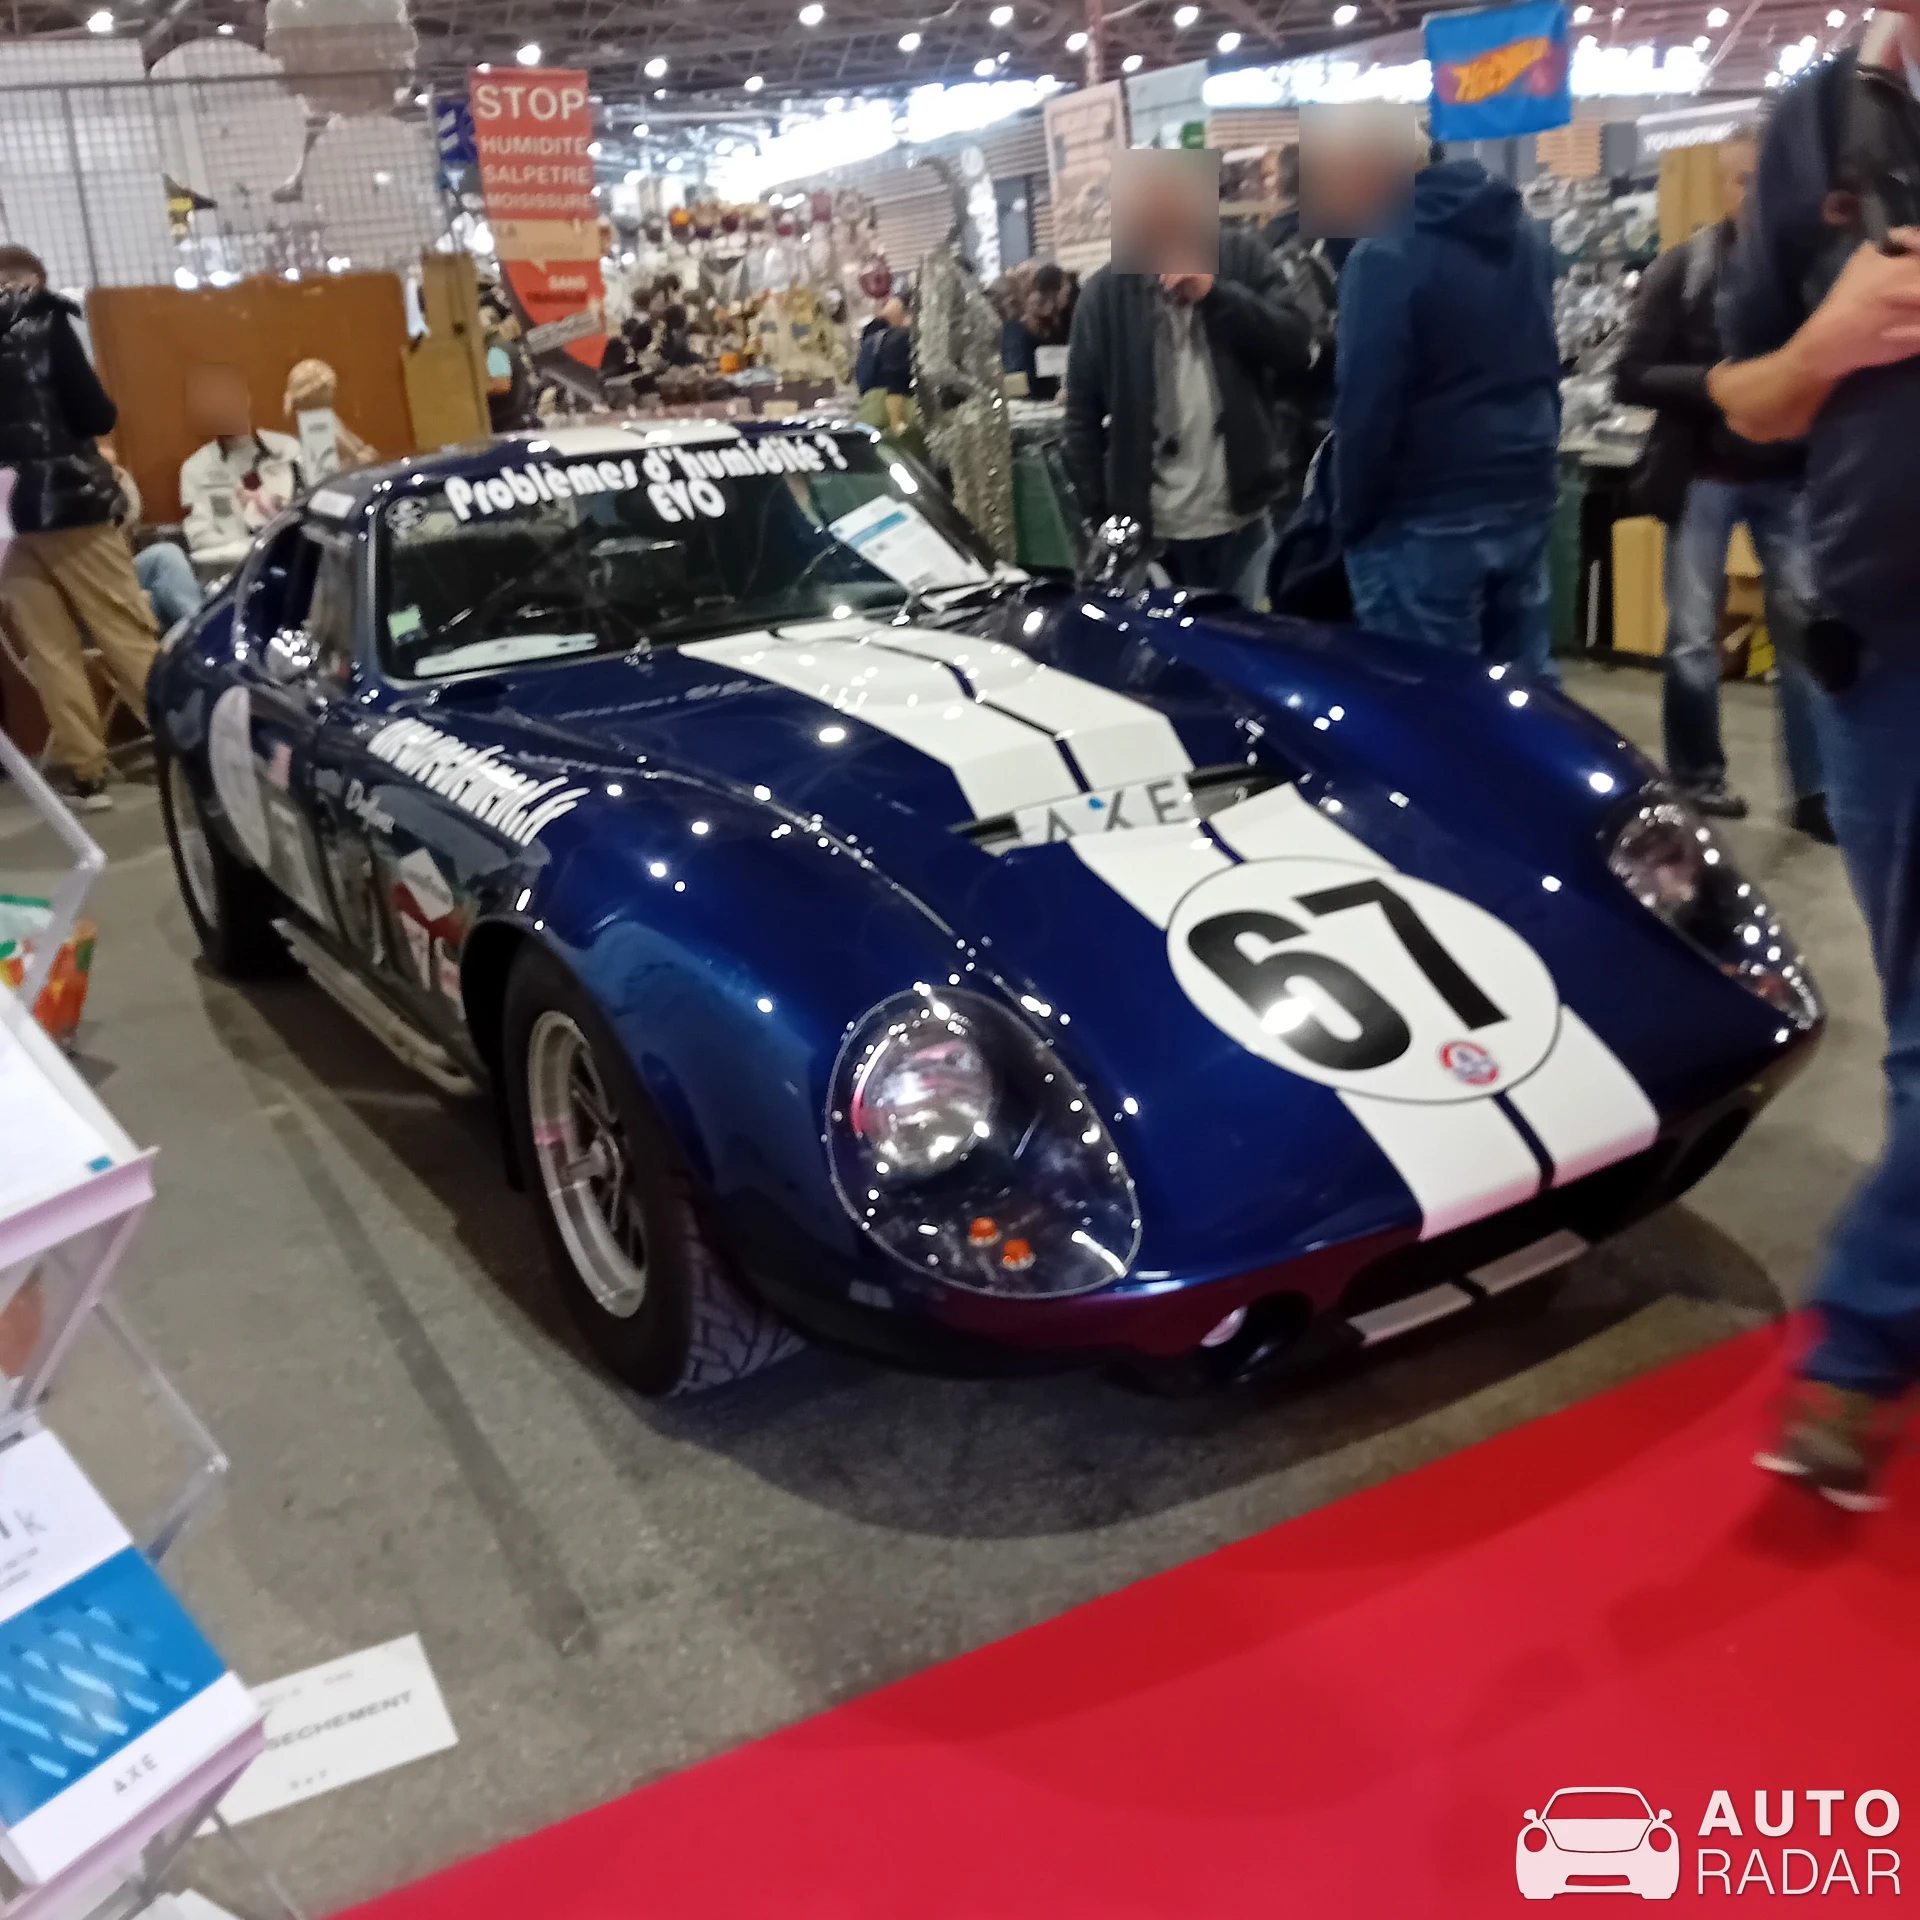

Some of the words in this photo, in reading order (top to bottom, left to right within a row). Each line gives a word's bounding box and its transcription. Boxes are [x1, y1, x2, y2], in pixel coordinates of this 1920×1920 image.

[475, 84, 585, 121] STOP
[483, 163, 592, 186] SALPETRE
[444, 458, 639, 522] Problèmes
[813, 433, 849, 471] ?
[646, 478, 727, 523] EVO
[1047, 779, 1191, 843] AXE
[1186, 876, 1511, 1072] 67
[112, 1751, 158, 1795] AXE
